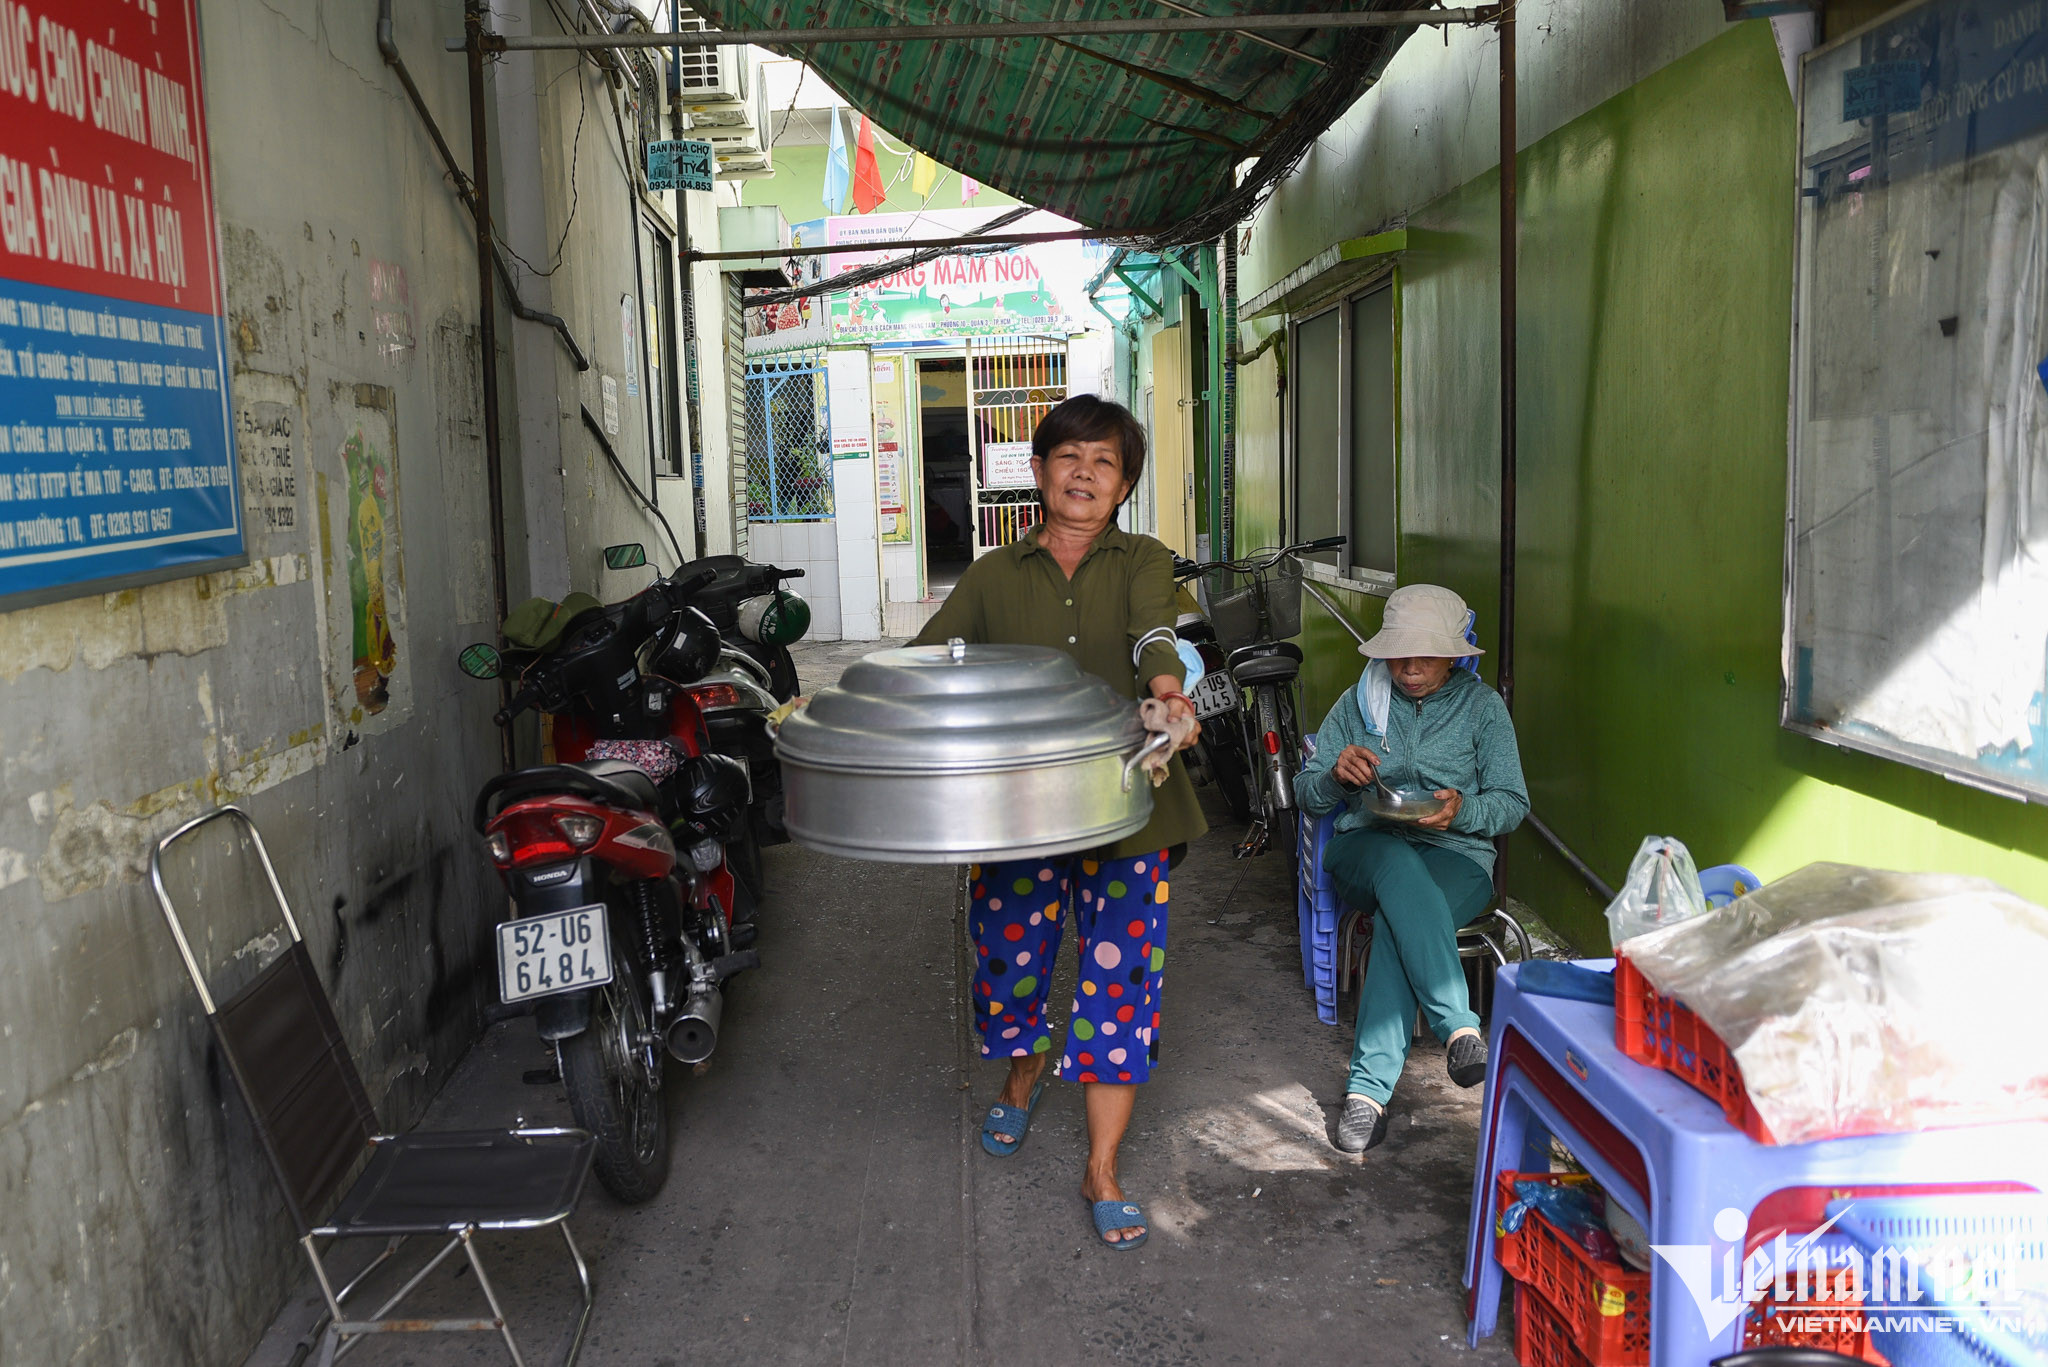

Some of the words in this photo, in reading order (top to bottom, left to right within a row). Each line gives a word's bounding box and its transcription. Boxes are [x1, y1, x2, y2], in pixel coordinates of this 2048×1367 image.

[38, 15, 85, 122] CHO
[86, 27, 147, 145] CHÍNH
[144, 51, 196, 180] MÌNH,
[650, 143, 667, 154] BÁN
[670, 142, 688, 152] NHÀ
[690, 144, 710, 156] CHỢ
[649, 180, 712, 191] 0934.104.853
[0, 154, 42, 258] GIA
[38, 146, 96, 269] ĐÌNH
[93, 164, 126, 275] VÀ
[123, 177, 154, 281] XÃ
[152, 184, 187, 303] HỘI
[995, 254, 1039, 282] NON
[41, 301, 66, 333] LIÊN
[67, 307, 96, 337] QUAN
[119, 316, 140, 341] MUA
[36, 350, 70, 380] CHỨC
[187, 366, 202, 389] MA
[55, 395, 72, 415] XIN
[71, 396, 88, 416] VUI
[88, 392, 112, 417] LÒNG
[111, 394, 131, 417] LIÊN
[12, 419, 46, 453] CÔNG
[46, 426, 65, 453] AN
[65, 421, 95, 458] QUẬN
[129, 428, 152, 451] 0283
[152, 428, 170, 451] 839
[14, 467, 39, 500] SÁT
[84, 471, 102, 495] MA
[16, 512, 66, 547] PHƯỜNG
[107, 511, 131, 537] 0283
[132, 510, 150, 533] 931
[150, 508, 172, 531] 6457
[533, 870, 568, 882] HONDA
[514, 914, 592, 957] 52-U6
[516, 949, 595, 993] 6484
